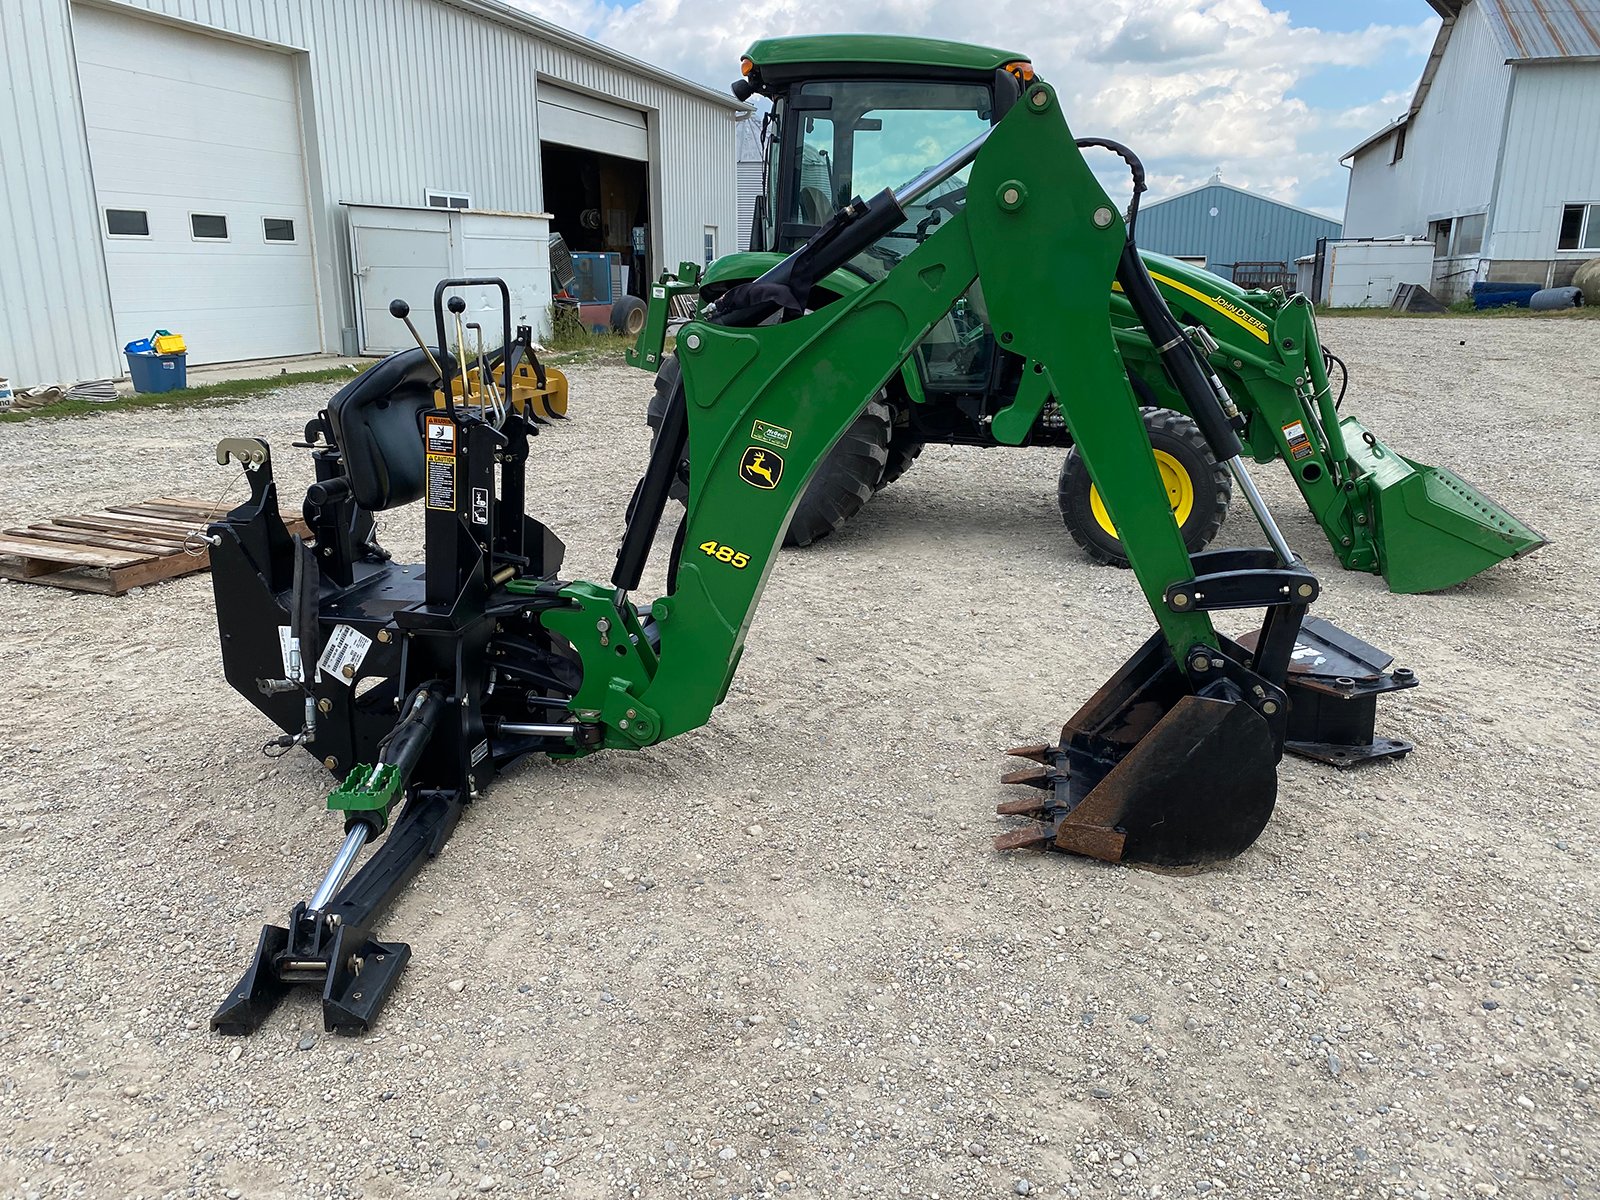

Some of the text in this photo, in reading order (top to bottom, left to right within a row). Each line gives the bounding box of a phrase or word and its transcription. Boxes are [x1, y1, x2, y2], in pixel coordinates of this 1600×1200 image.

[1211, 295, 1268, 332] JOHN DEERE
[698, 540, 752, 570] 485
